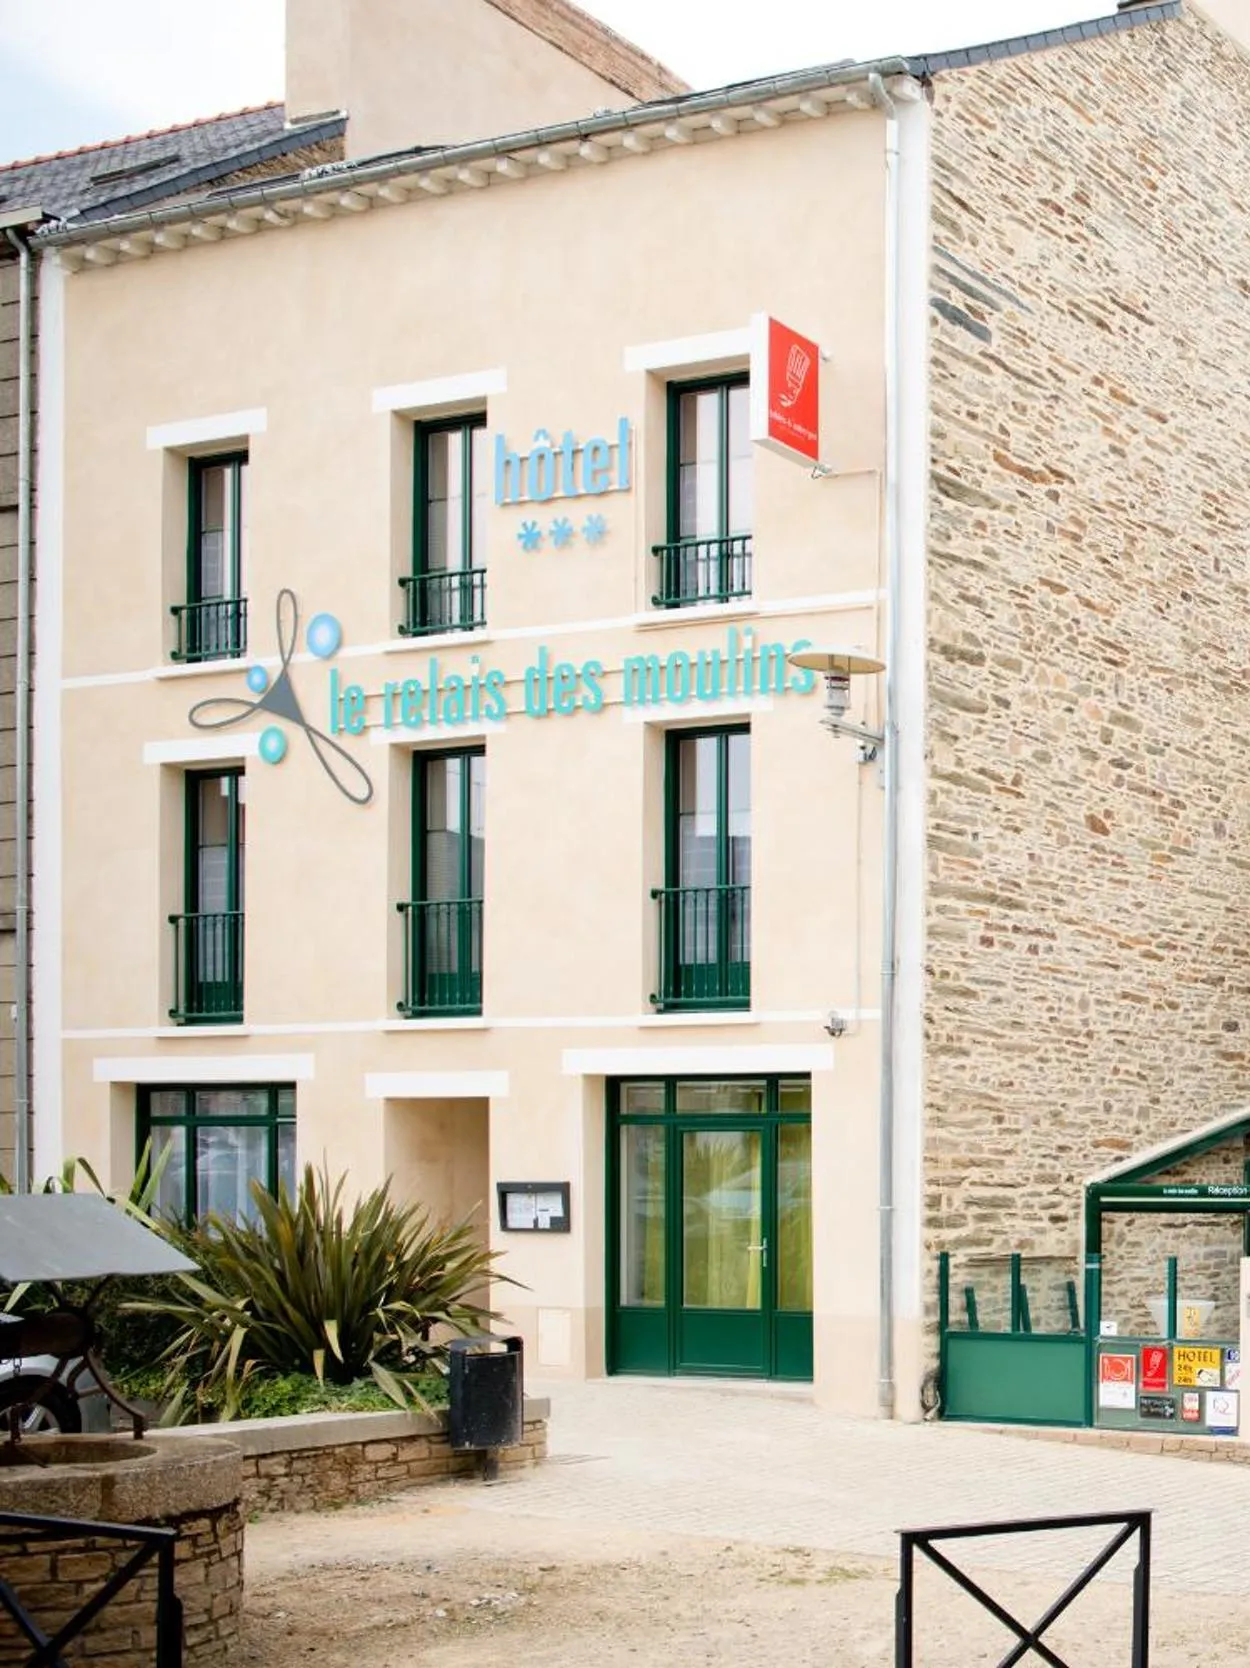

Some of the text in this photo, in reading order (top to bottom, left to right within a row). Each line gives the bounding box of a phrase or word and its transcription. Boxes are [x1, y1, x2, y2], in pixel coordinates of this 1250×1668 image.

[495, 416, 630, 506] hôtel
[329, 626, 816, 735] le relais des moulins
[1207, 1185, 1248, 1197] Réception
[1177, 1350, 1216, 1364] HOTEL
